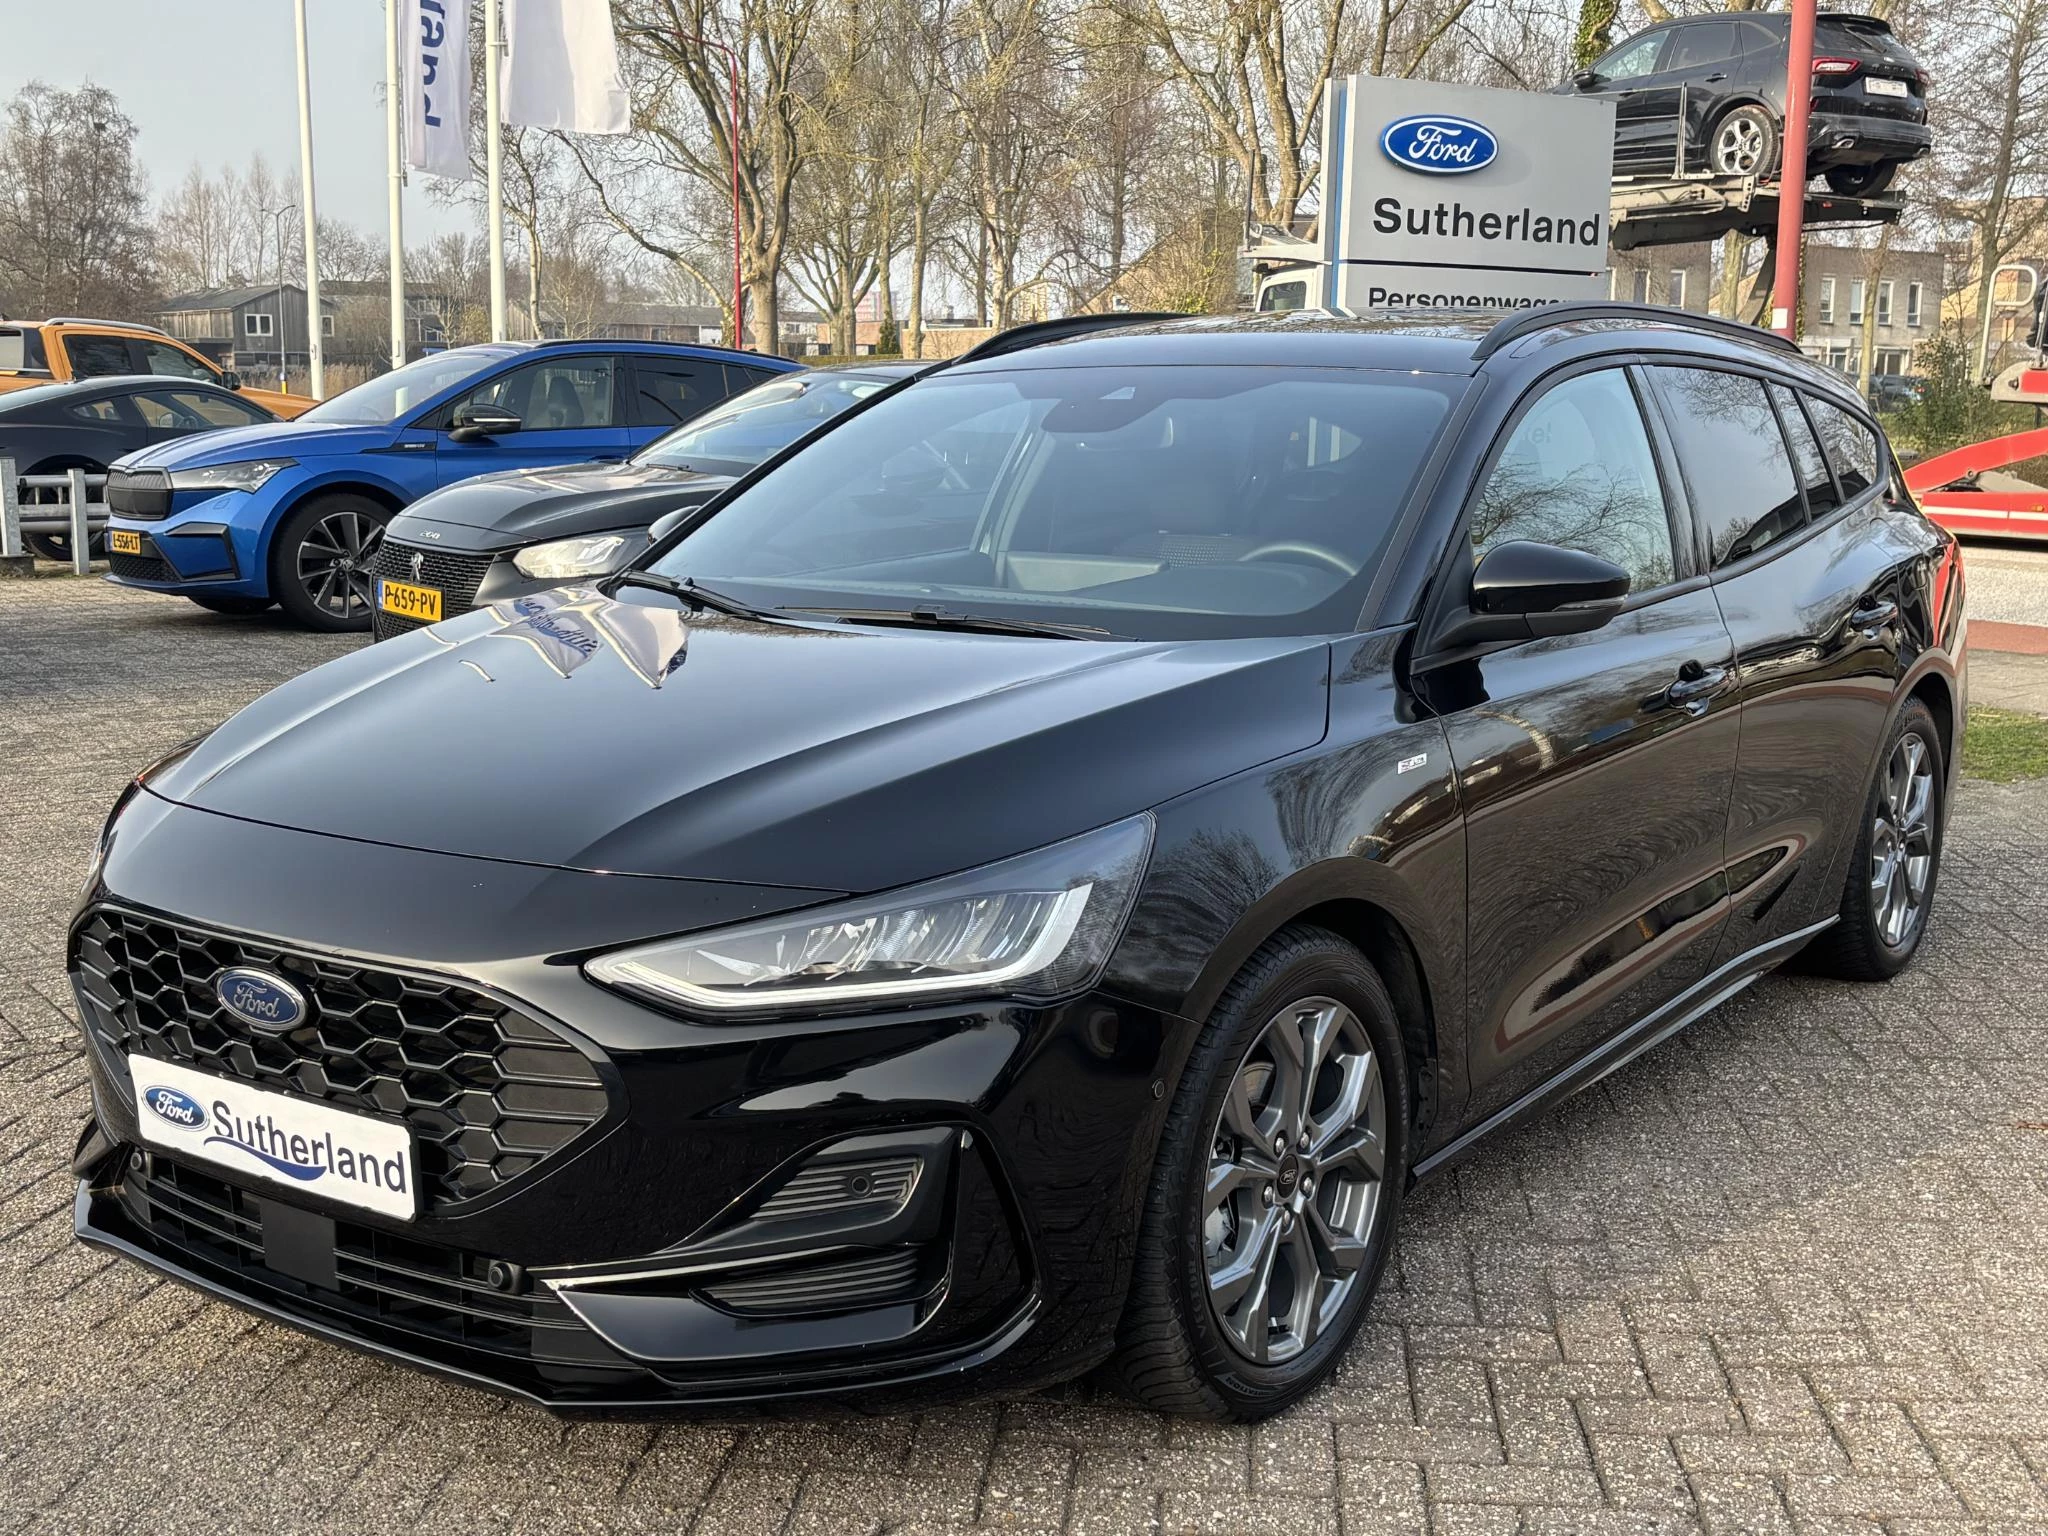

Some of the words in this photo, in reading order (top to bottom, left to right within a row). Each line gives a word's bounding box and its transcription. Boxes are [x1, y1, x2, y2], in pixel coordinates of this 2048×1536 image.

[1408, 124, 1479, 163] Ford
[1372, 197, 1601, 247] Sutherland
[384, 583, 437, 616] P-659-PV
[233, 980, 280, 1018] Ford
[155, 1090, 195, 1124] Ford
[212, 1100, 407, 1195] Sutherland
